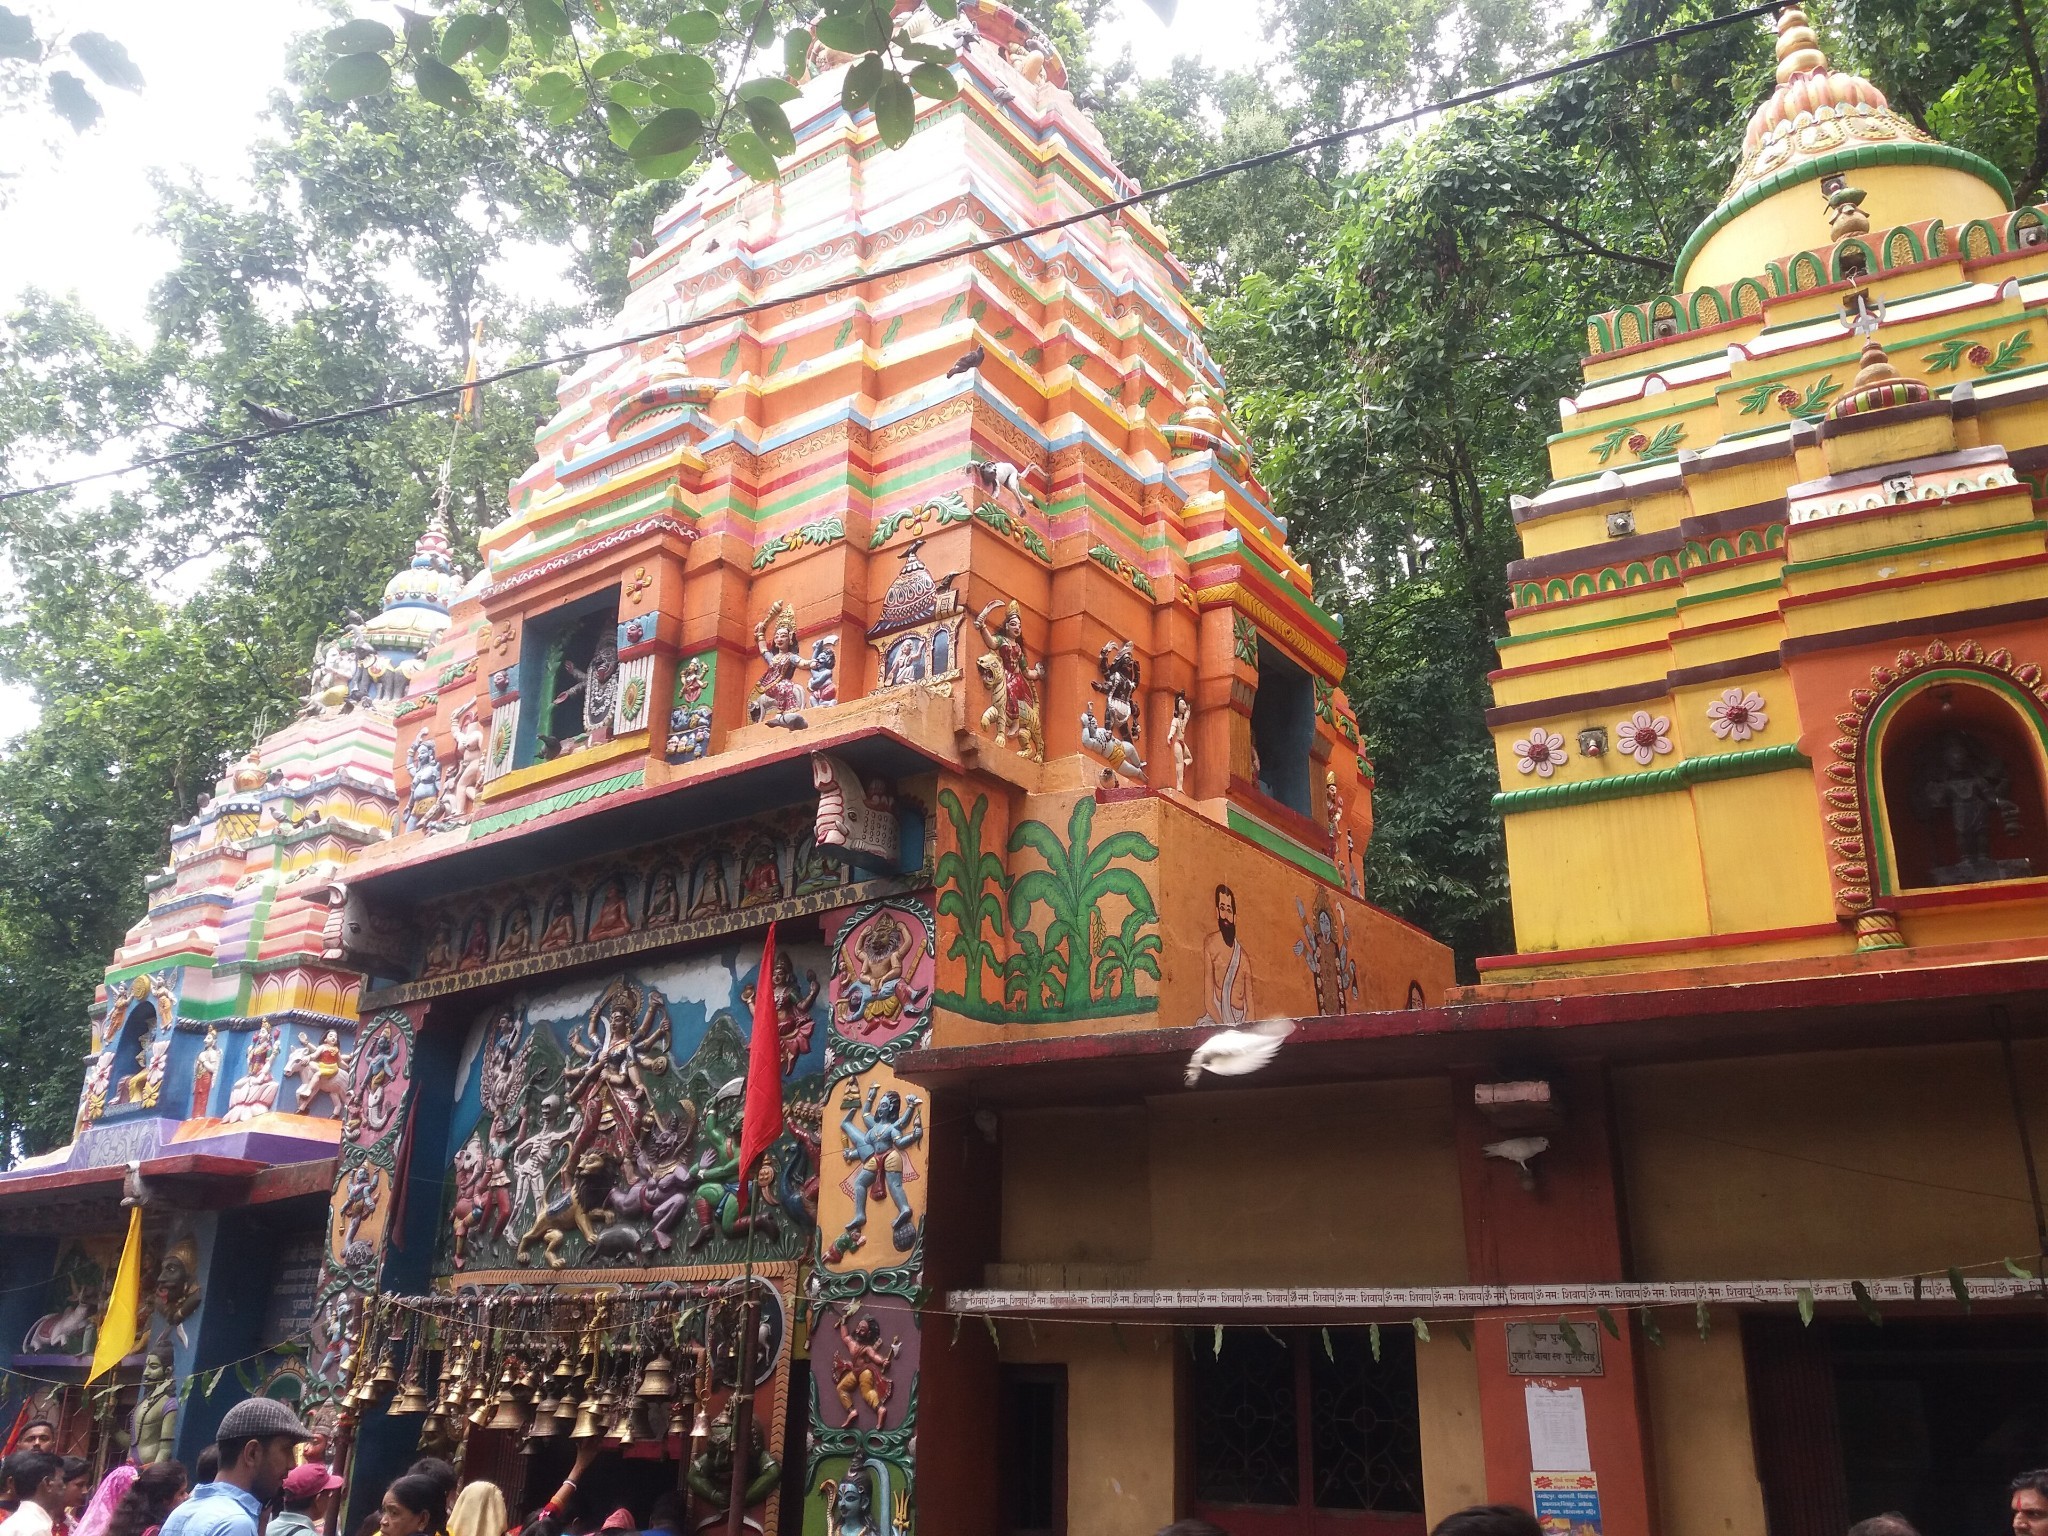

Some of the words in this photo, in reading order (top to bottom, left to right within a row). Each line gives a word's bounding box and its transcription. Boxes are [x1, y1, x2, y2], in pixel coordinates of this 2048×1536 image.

[1091, 1294, 1110, 1304] शिवाय
[1120, 1296, 1131, 1304] नमः
[1134, 1293, 1153, 1304] शिवाय
[1163, 1296, 1174, 1304] नमः
[1177, 1293, 1196, 1304] शिवाय
[1221, 1292, 1241, 1304] शिवाय
[1252, 1295, 1265, 1303] नमः
[1267, 1292, 1287, 1303] शिवाय
[1313, 1291, 1334, 1303] शिवाय
[1361, 1291, 1382, 1303] शिवाय
[1394, 1294, 1407, 1302] नमः
[1410, 1291, 1431, 1302] शिवाय
[1459, 1290, 1482, 1301] शिवाय
[1510, 1289, 1533, 1300] शिवाय
[1562, 1289, 1585, 1300] शिवाय
[1598, 1291, 1613, 1299] नमः
[1616, 1287, 1640, 1299] शिवाय
[1652, 1290, 1668, 1298] नमः
[1670, 1287, 1695, 1298] शिवाय
[1708, 1288, 1723, 1297] नमः
[1726, 1286, 1752, 1297] शिवाय
[1766, 1288, 1782, 1296] नमः
[1885, 1287, 1901, 1295] नमः
[1967, 1282, 1995, 1294] शिवाय
[2009, 1285, 2026, 1293] नमः
